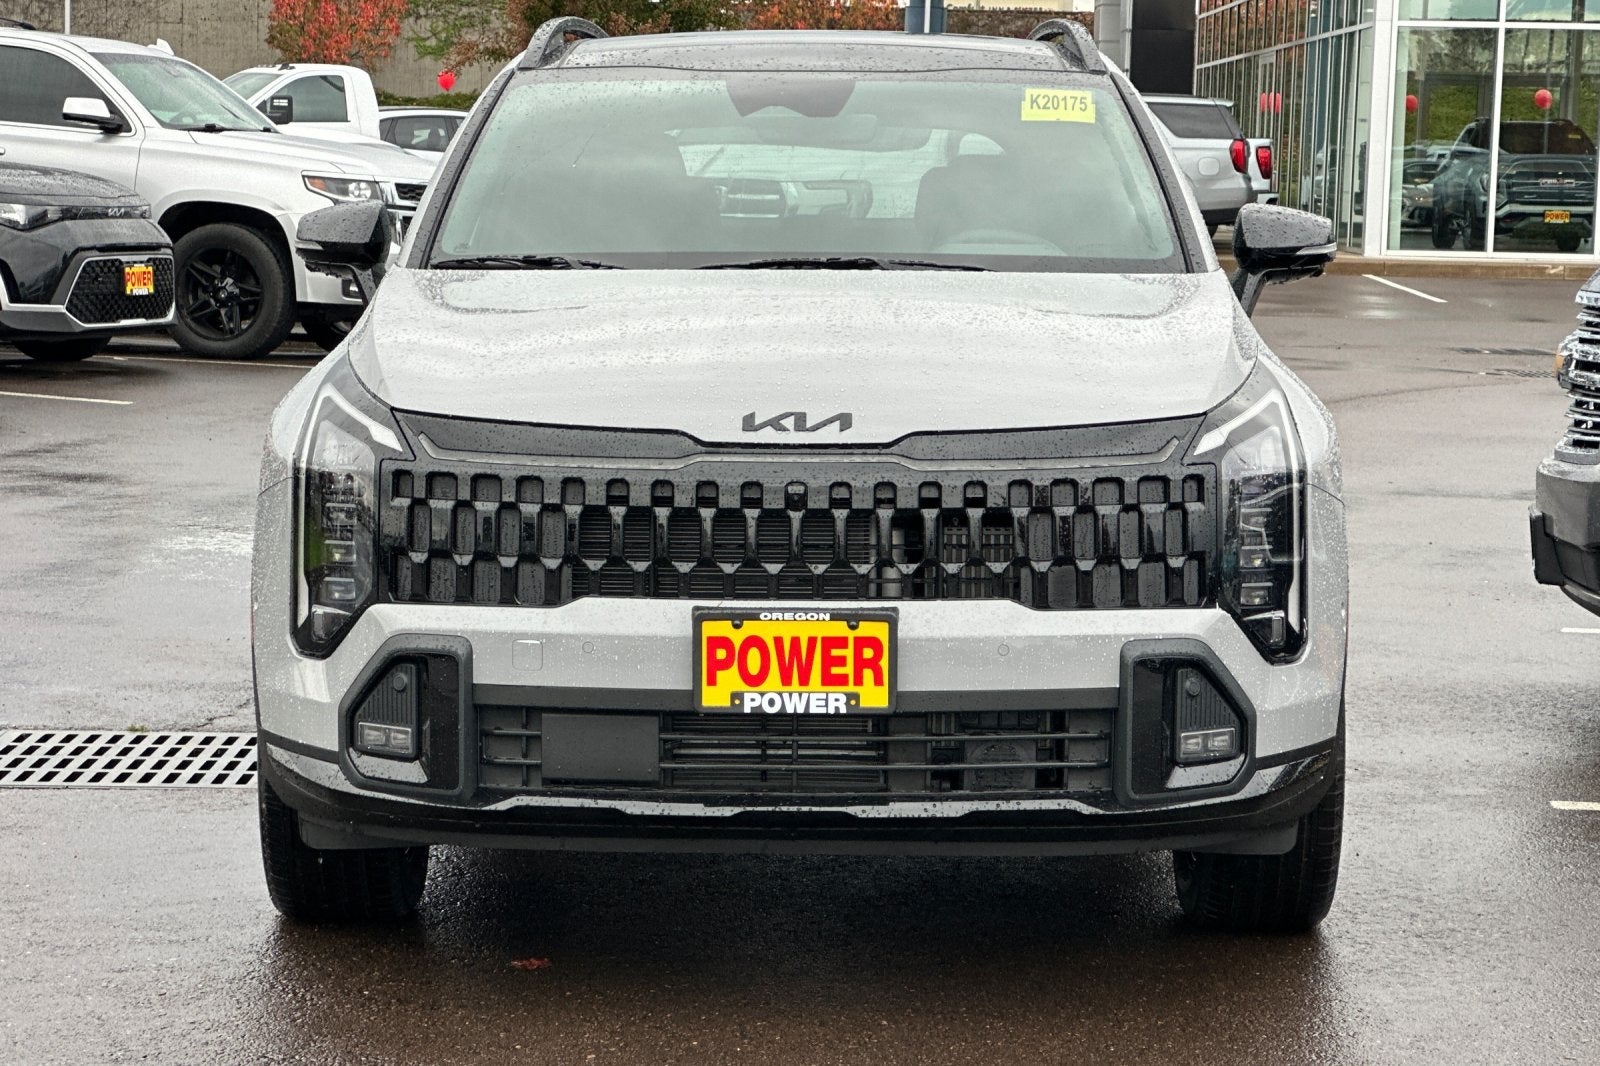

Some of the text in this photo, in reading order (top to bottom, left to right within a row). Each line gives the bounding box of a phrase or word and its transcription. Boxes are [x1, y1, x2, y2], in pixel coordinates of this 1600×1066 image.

[1029, 92, 1088, 112] K20175
[1545, 212, 1569, 220] POWER
[126, 270, 152, 287] POWER
[742, 411, 853, 433] KIA
[759, 612, 831, 621] OREGON
[706, 635, 884, 687] POWER
[743, 692, 847, 714] POWER
